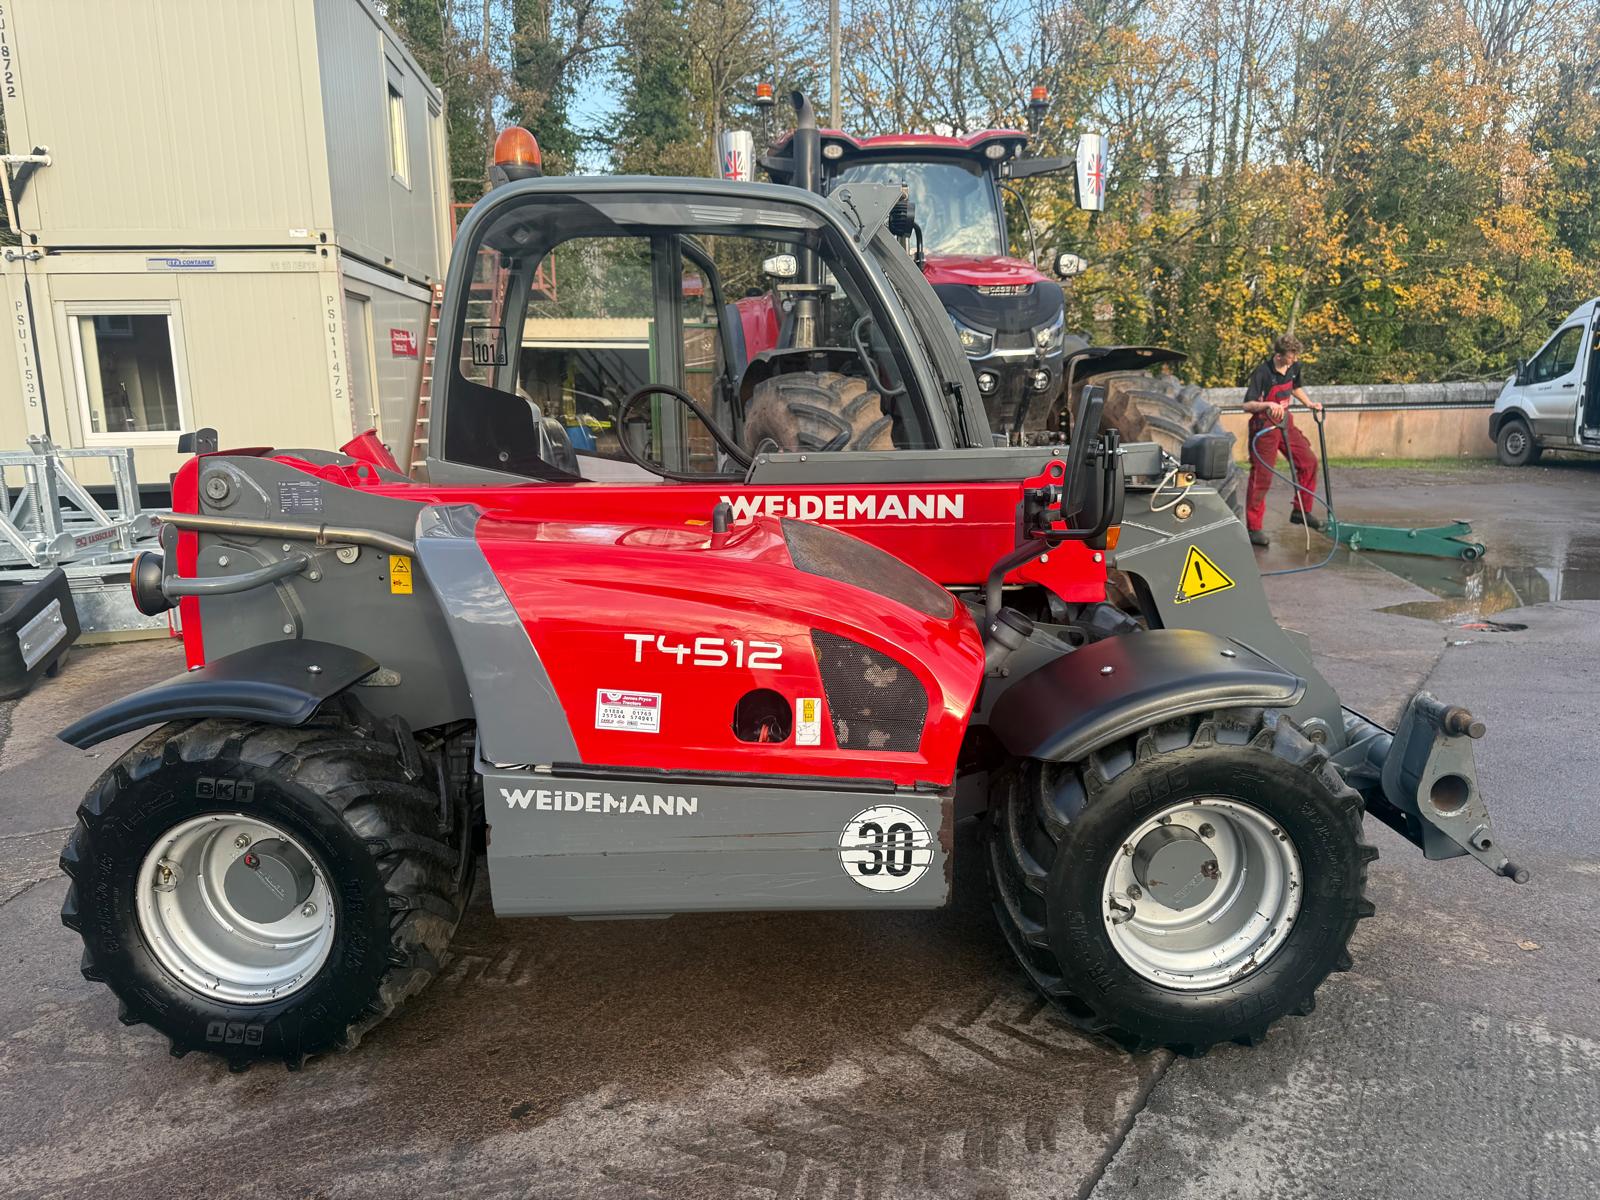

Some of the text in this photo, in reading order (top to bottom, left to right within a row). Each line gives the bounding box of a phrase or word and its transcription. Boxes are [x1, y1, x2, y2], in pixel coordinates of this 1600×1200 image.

[15, 300, 37, 407] PSU11535
[326, 295, 342, 399] PSU11472
[475, 344, 496, 363] 101
[623, 633, 783, 670] T4512
[197, 778, 254, 801] BKT
[857, 821, 914, 877] 30
